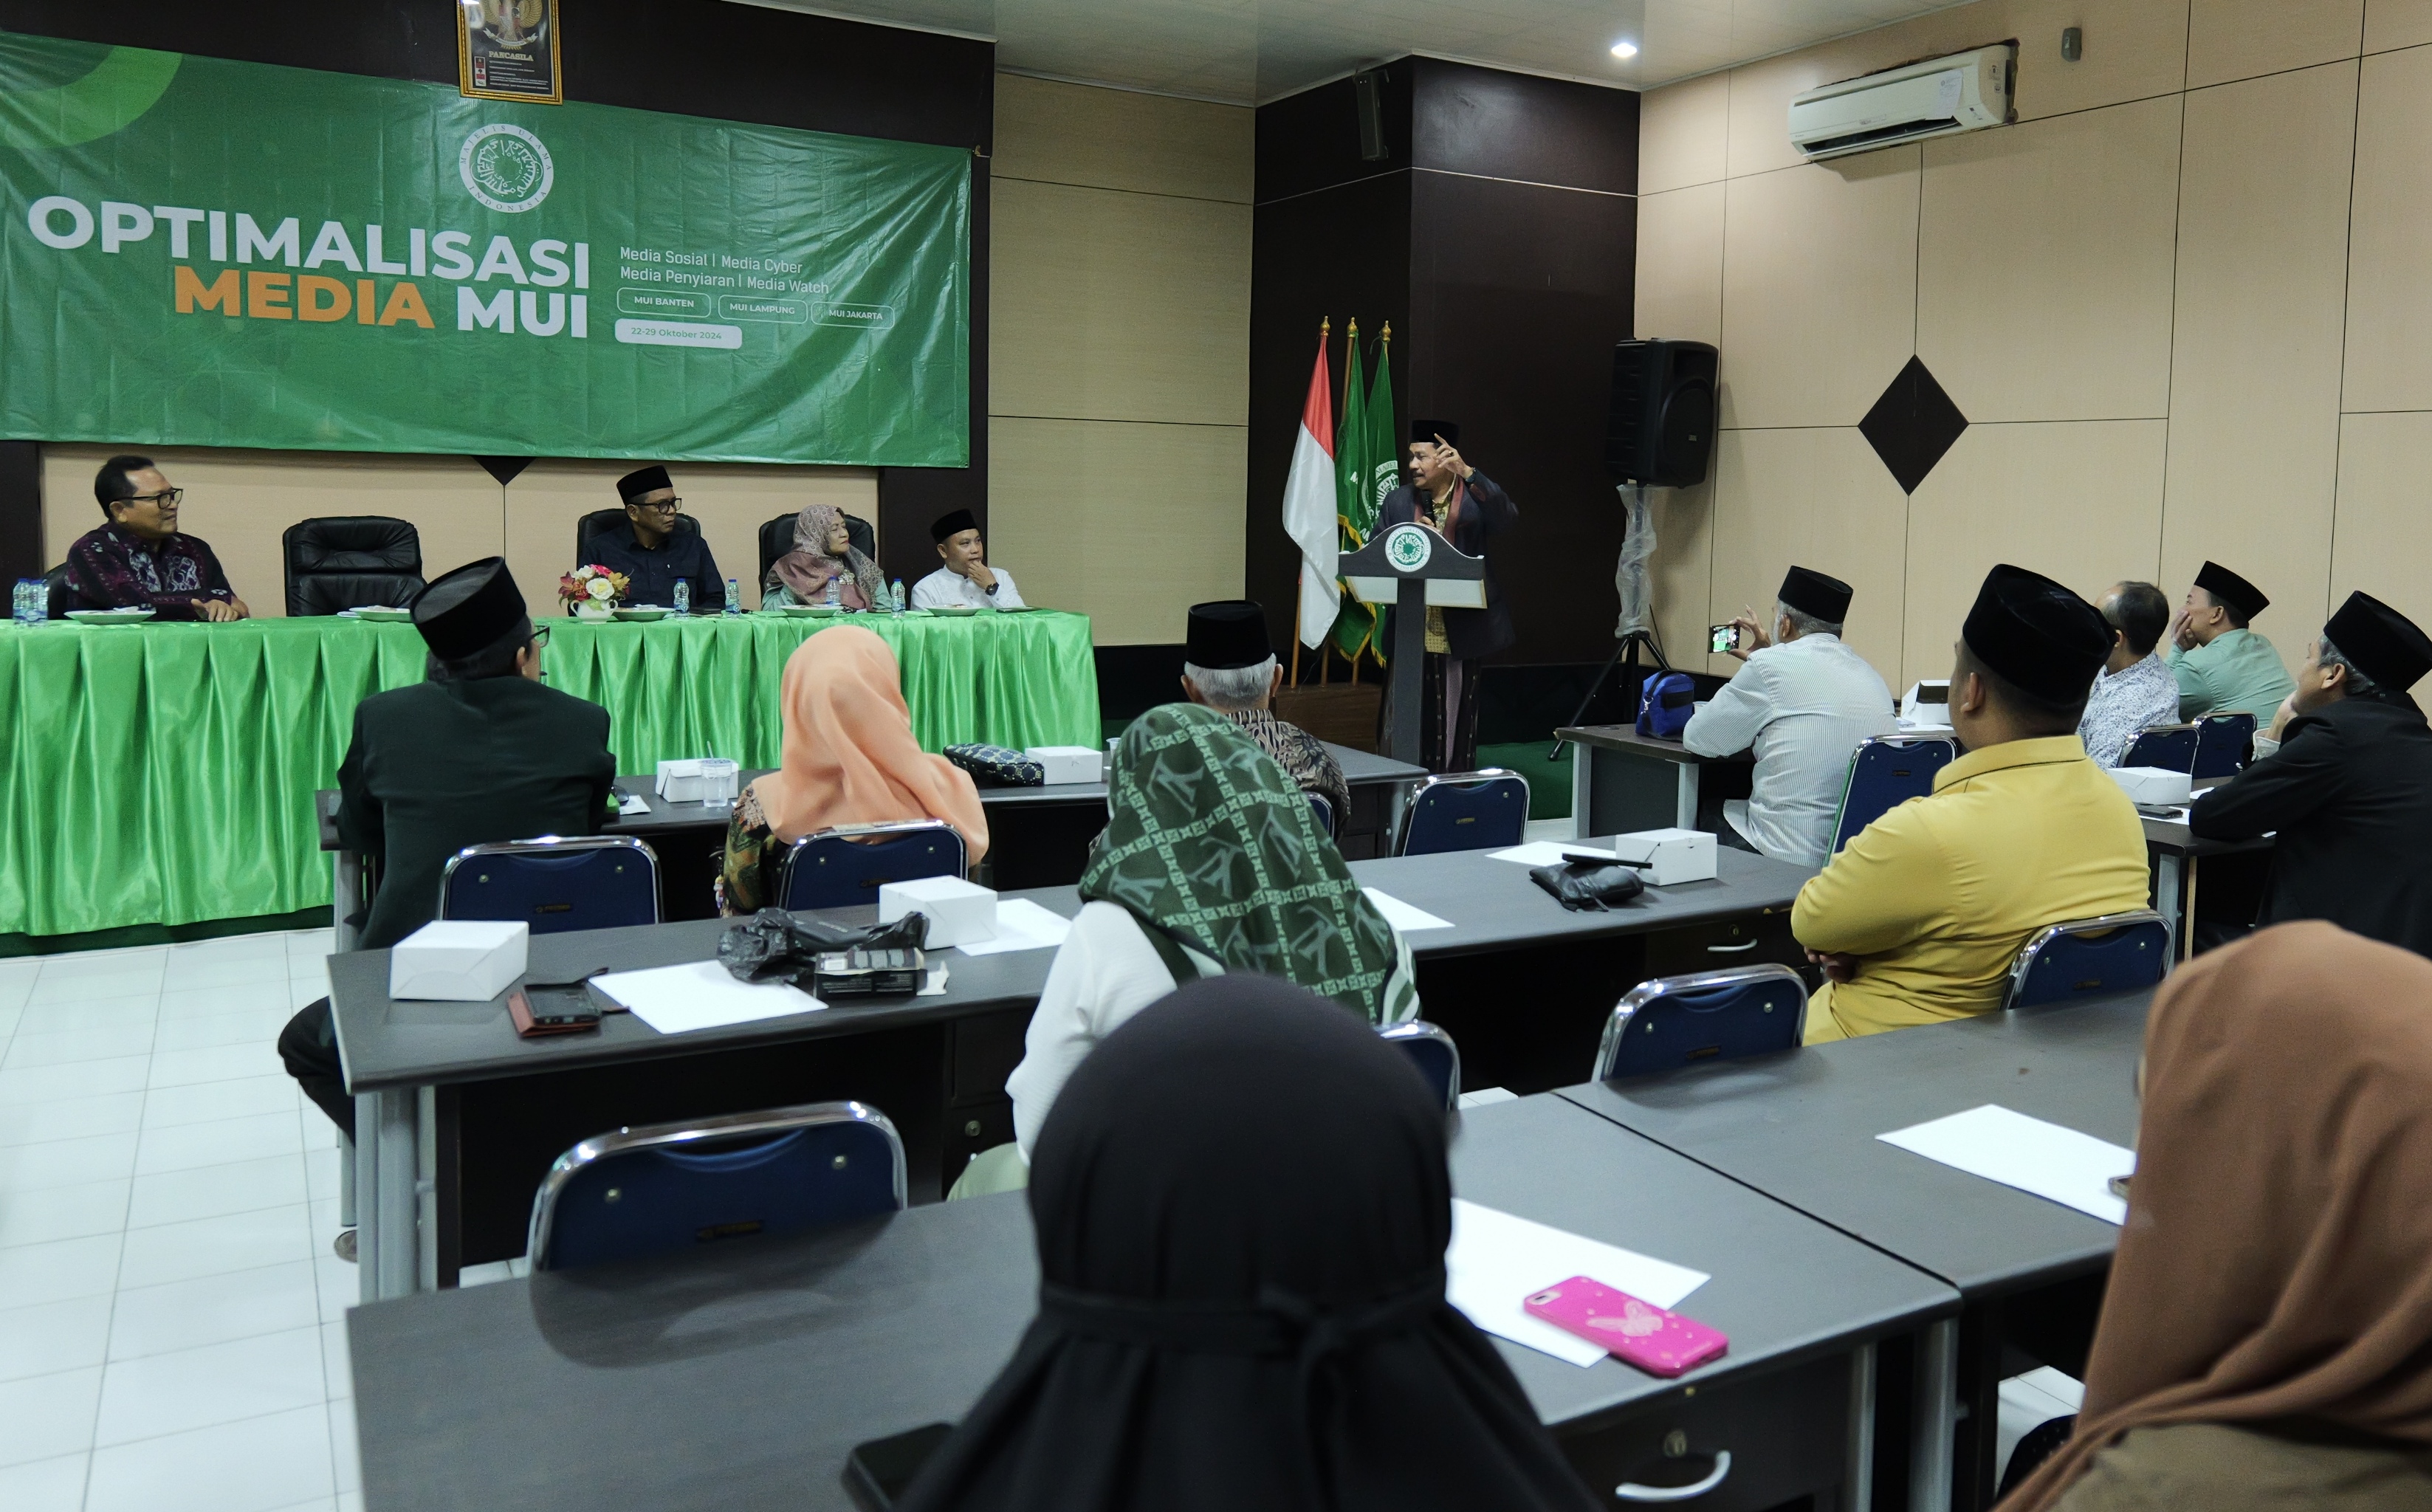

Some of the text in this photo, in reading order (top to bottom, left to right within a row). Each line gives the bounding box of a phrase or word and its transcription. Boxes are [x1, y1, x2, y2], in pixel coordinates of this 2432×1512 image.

[489, 51, 534, 61] PANCASILA
[460, 126, 552, 171] MAJELIS ULAMA
[469, 191, 546, 212] INDONESIA
[27, 196, 589, 289] OPTIMALISASI
[620, 247, 662, 263] Media
[665, 250, 708, 267] Sosial
[721, 255, 760, 271] Media
[764, 259, 803, 275] Cyber
[620, 266, 662, 282] Media
[666, 270, 735, 288] Penyiaran
[747, 276, 786, 292] Media
[789, 280, 829, 295] Watch
[174, 266, 588, 338] MEDIA MUI
[633, 295, 694, 308] MUI BANTEN
[729, 302, 795, 315] MUI LAMPUNG
[828, 309, 883, 320] MUI JAKARTA
[631, 327, 722, 340] 22-29 Oktober 2024
